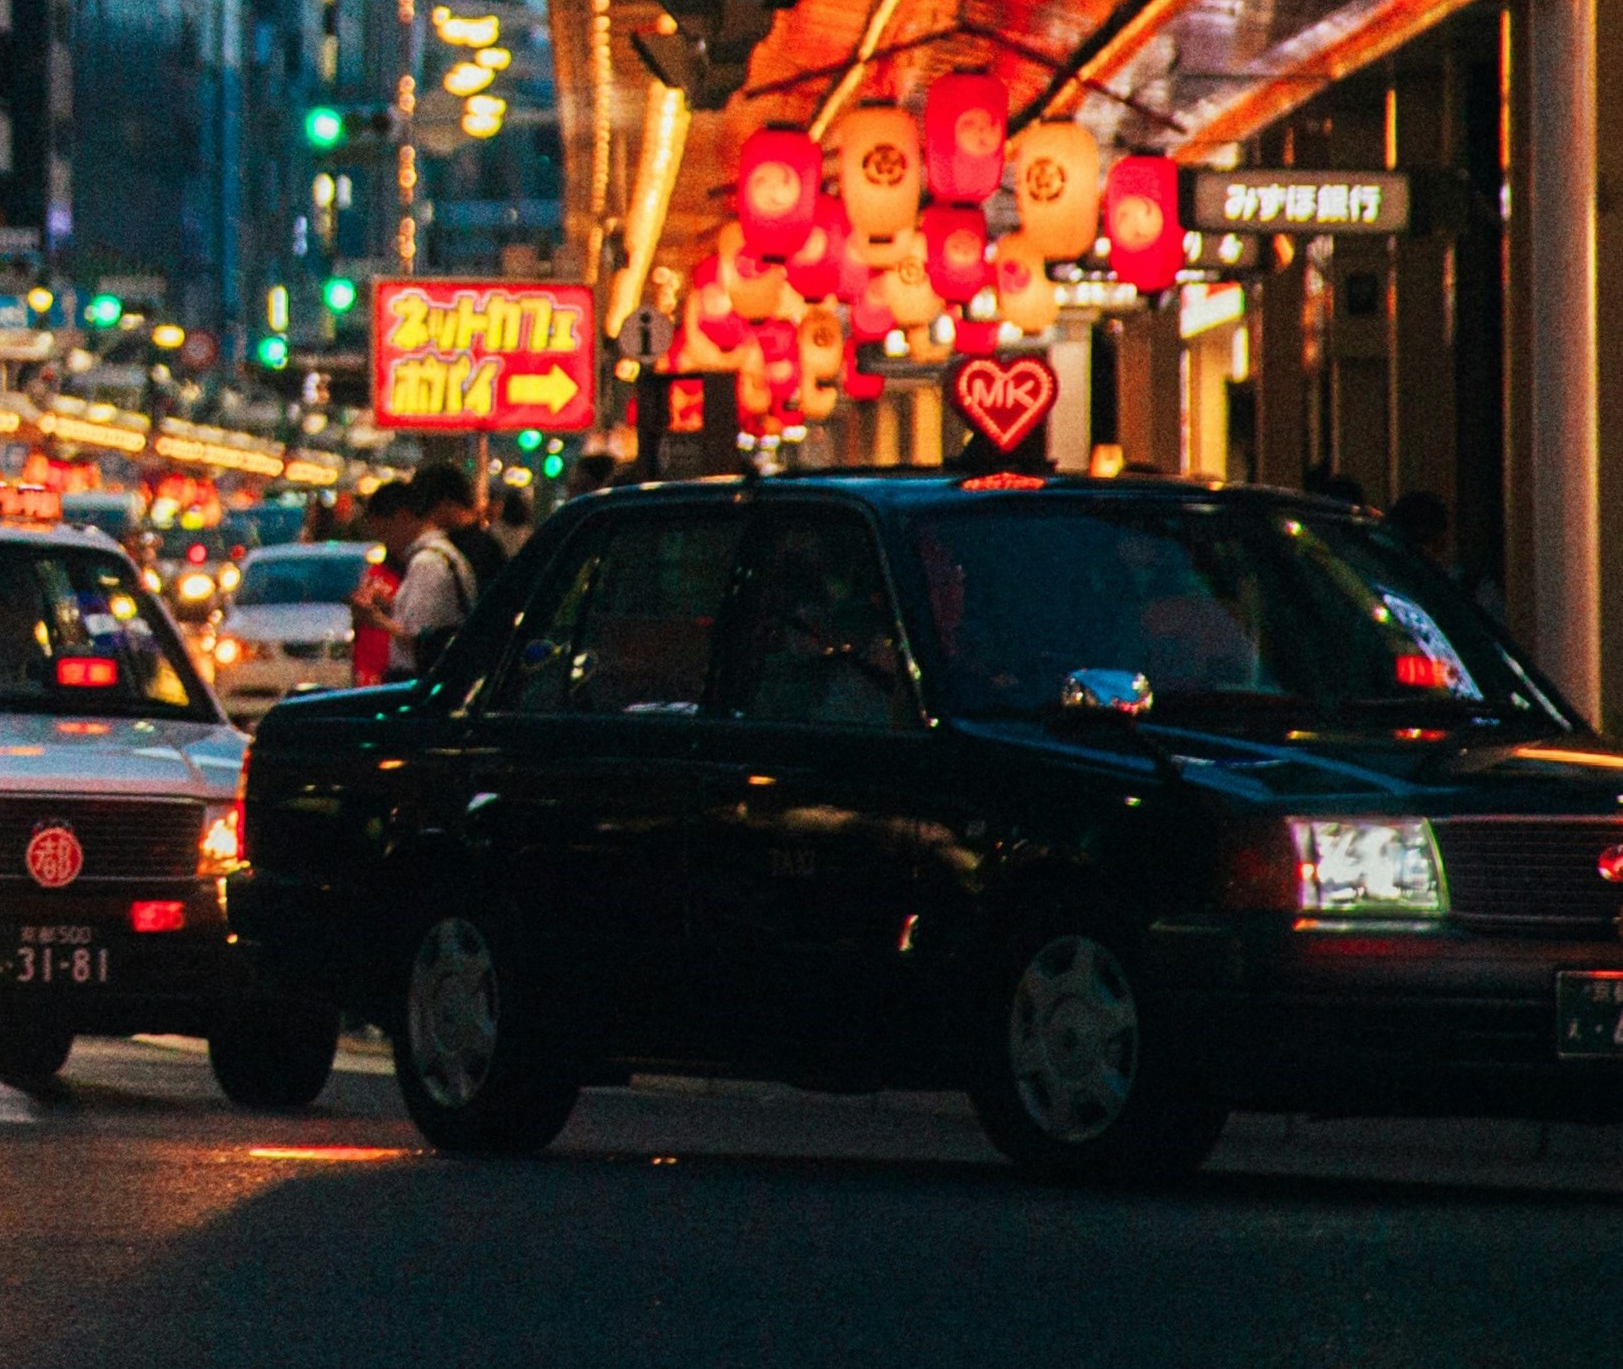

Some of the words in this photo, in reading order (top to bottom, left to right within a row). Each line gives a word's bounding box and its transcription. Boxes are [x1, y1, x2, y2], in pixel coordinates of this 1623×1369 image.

[1226, 183, 1381, 222] みずほ銀行
[391, 292, 579, 351] ネットカフェ
[972, 378, 1036, 410] MK
[16, 946, 109, 983] 31-81
